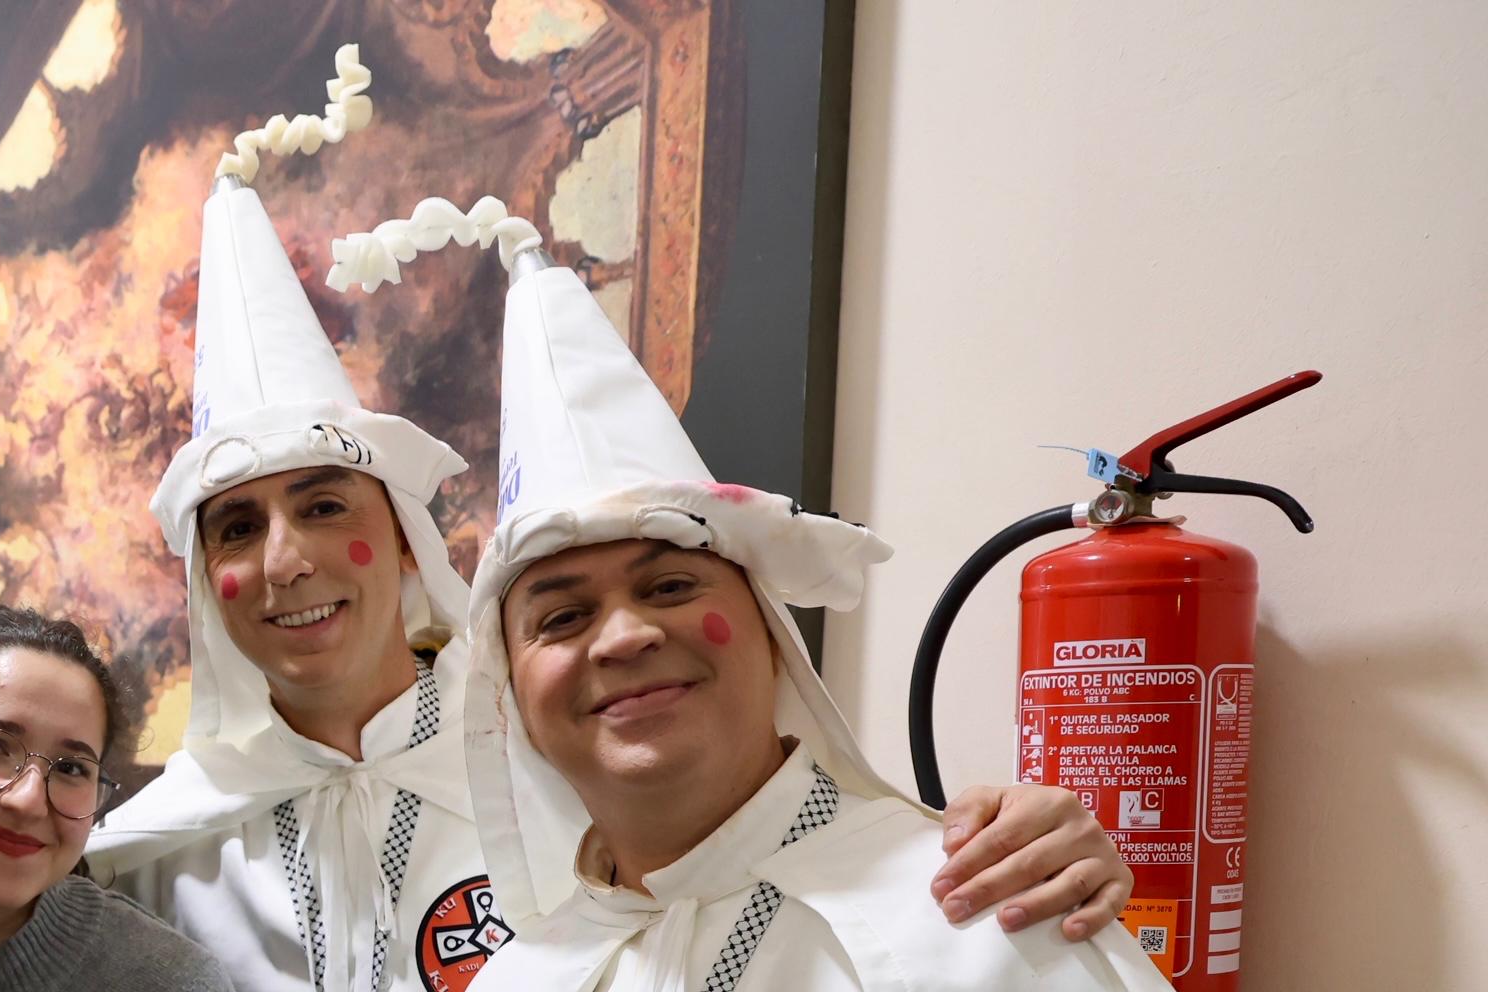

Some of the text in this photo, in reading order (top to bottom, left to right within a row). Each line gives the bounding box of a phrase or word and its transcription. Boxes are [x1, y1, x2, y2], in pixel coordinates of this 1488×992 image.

[1055, 643, 1143, 662] GLORIA
[1023, 671, 1196, 690] EXTINTOR DE INCENDIOS
[1083, 687, 1111, 696] POLVO
[1112, 687, 1130, 695] ABC
[1060, 715, 1097, 725] QUITAR
[1101, 715, 1113, 723] EL
[1116, 713, 1170, 723] PASADOR
[1060, 725, 1139, 735] DE SEGURIDAD
[1059, 746, 1105, 755] APRETAR
[1110, 746, 1123, 755] LA
[1126, 745, 1177, 754] PALANCA
[1059, 756, 1139, 766] DE LA VALVULA
[1059, 766, 1173, 776] DIRIGIR EL CHORRO A
[1059, 776, 1187, 786] LA BASE DE LAS LLAMAS
[1081, 792, 1094, 808] B
[1145, 791, 1159, 808] C
[1120, 842, 1193, 852] PRESENCIA DE
[1152, 852, 1194, 862] VOLTIOS.
[434, 896, 457, 919] KU
[485, 928, 500, 944] K
